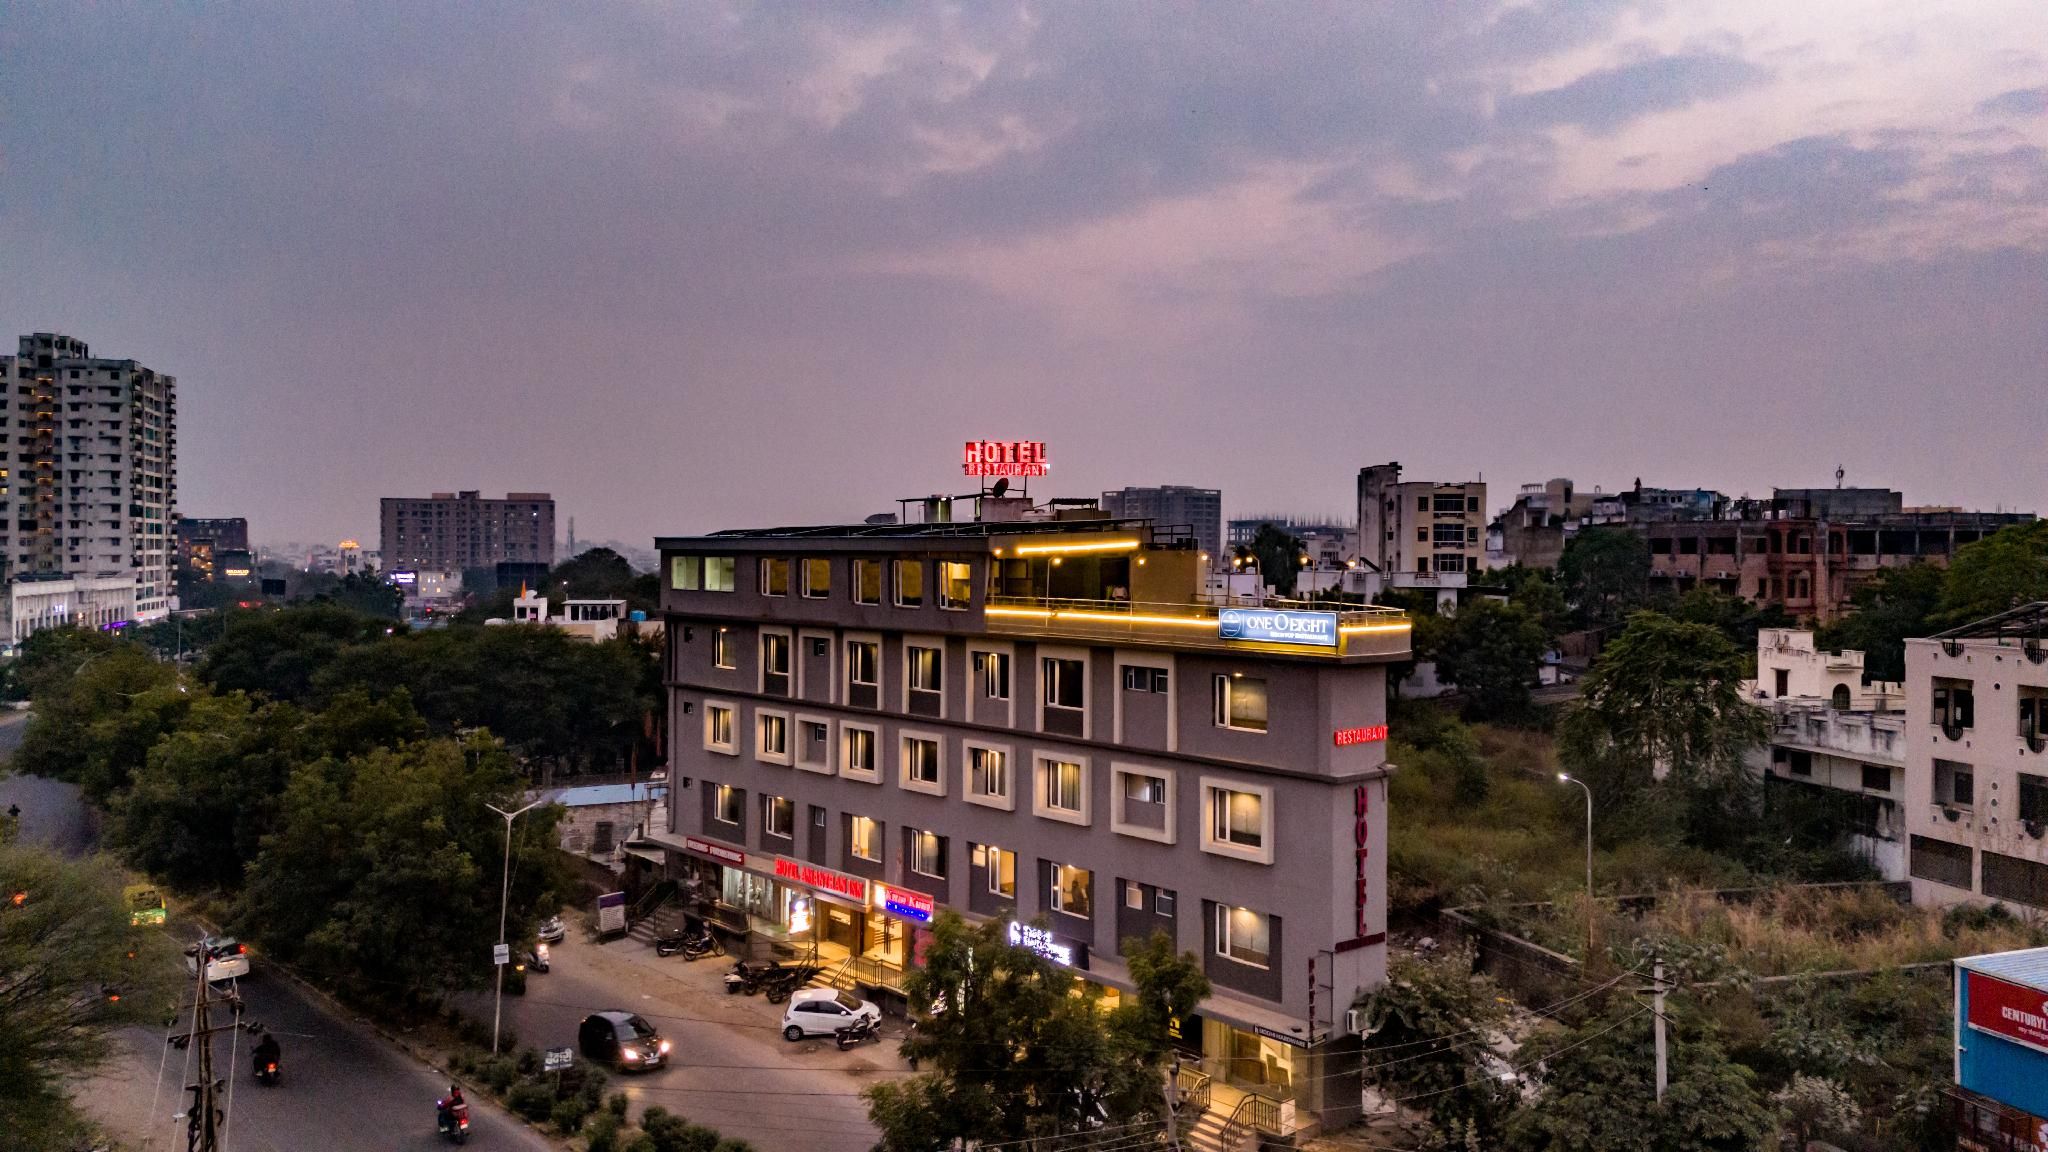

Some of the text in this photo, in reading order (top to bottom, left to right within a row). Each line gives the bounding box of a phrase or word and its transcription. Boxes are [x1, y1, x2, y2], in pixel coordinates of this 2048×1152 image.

[965, 442, 1047, 463] HOTEL
[966, 463, 1047, 476] RESTAURANT
[1246, 616, 1273, 630] ONE
[1289, 618, 1329, 633] EIGHT
[1335, 725, 1389, 746] RESTAURANT
[1355, 784, 1369, 938] HOTEL
[775, 858, 799, 881] HOTEL
[848, 879, 865, 900] INN
